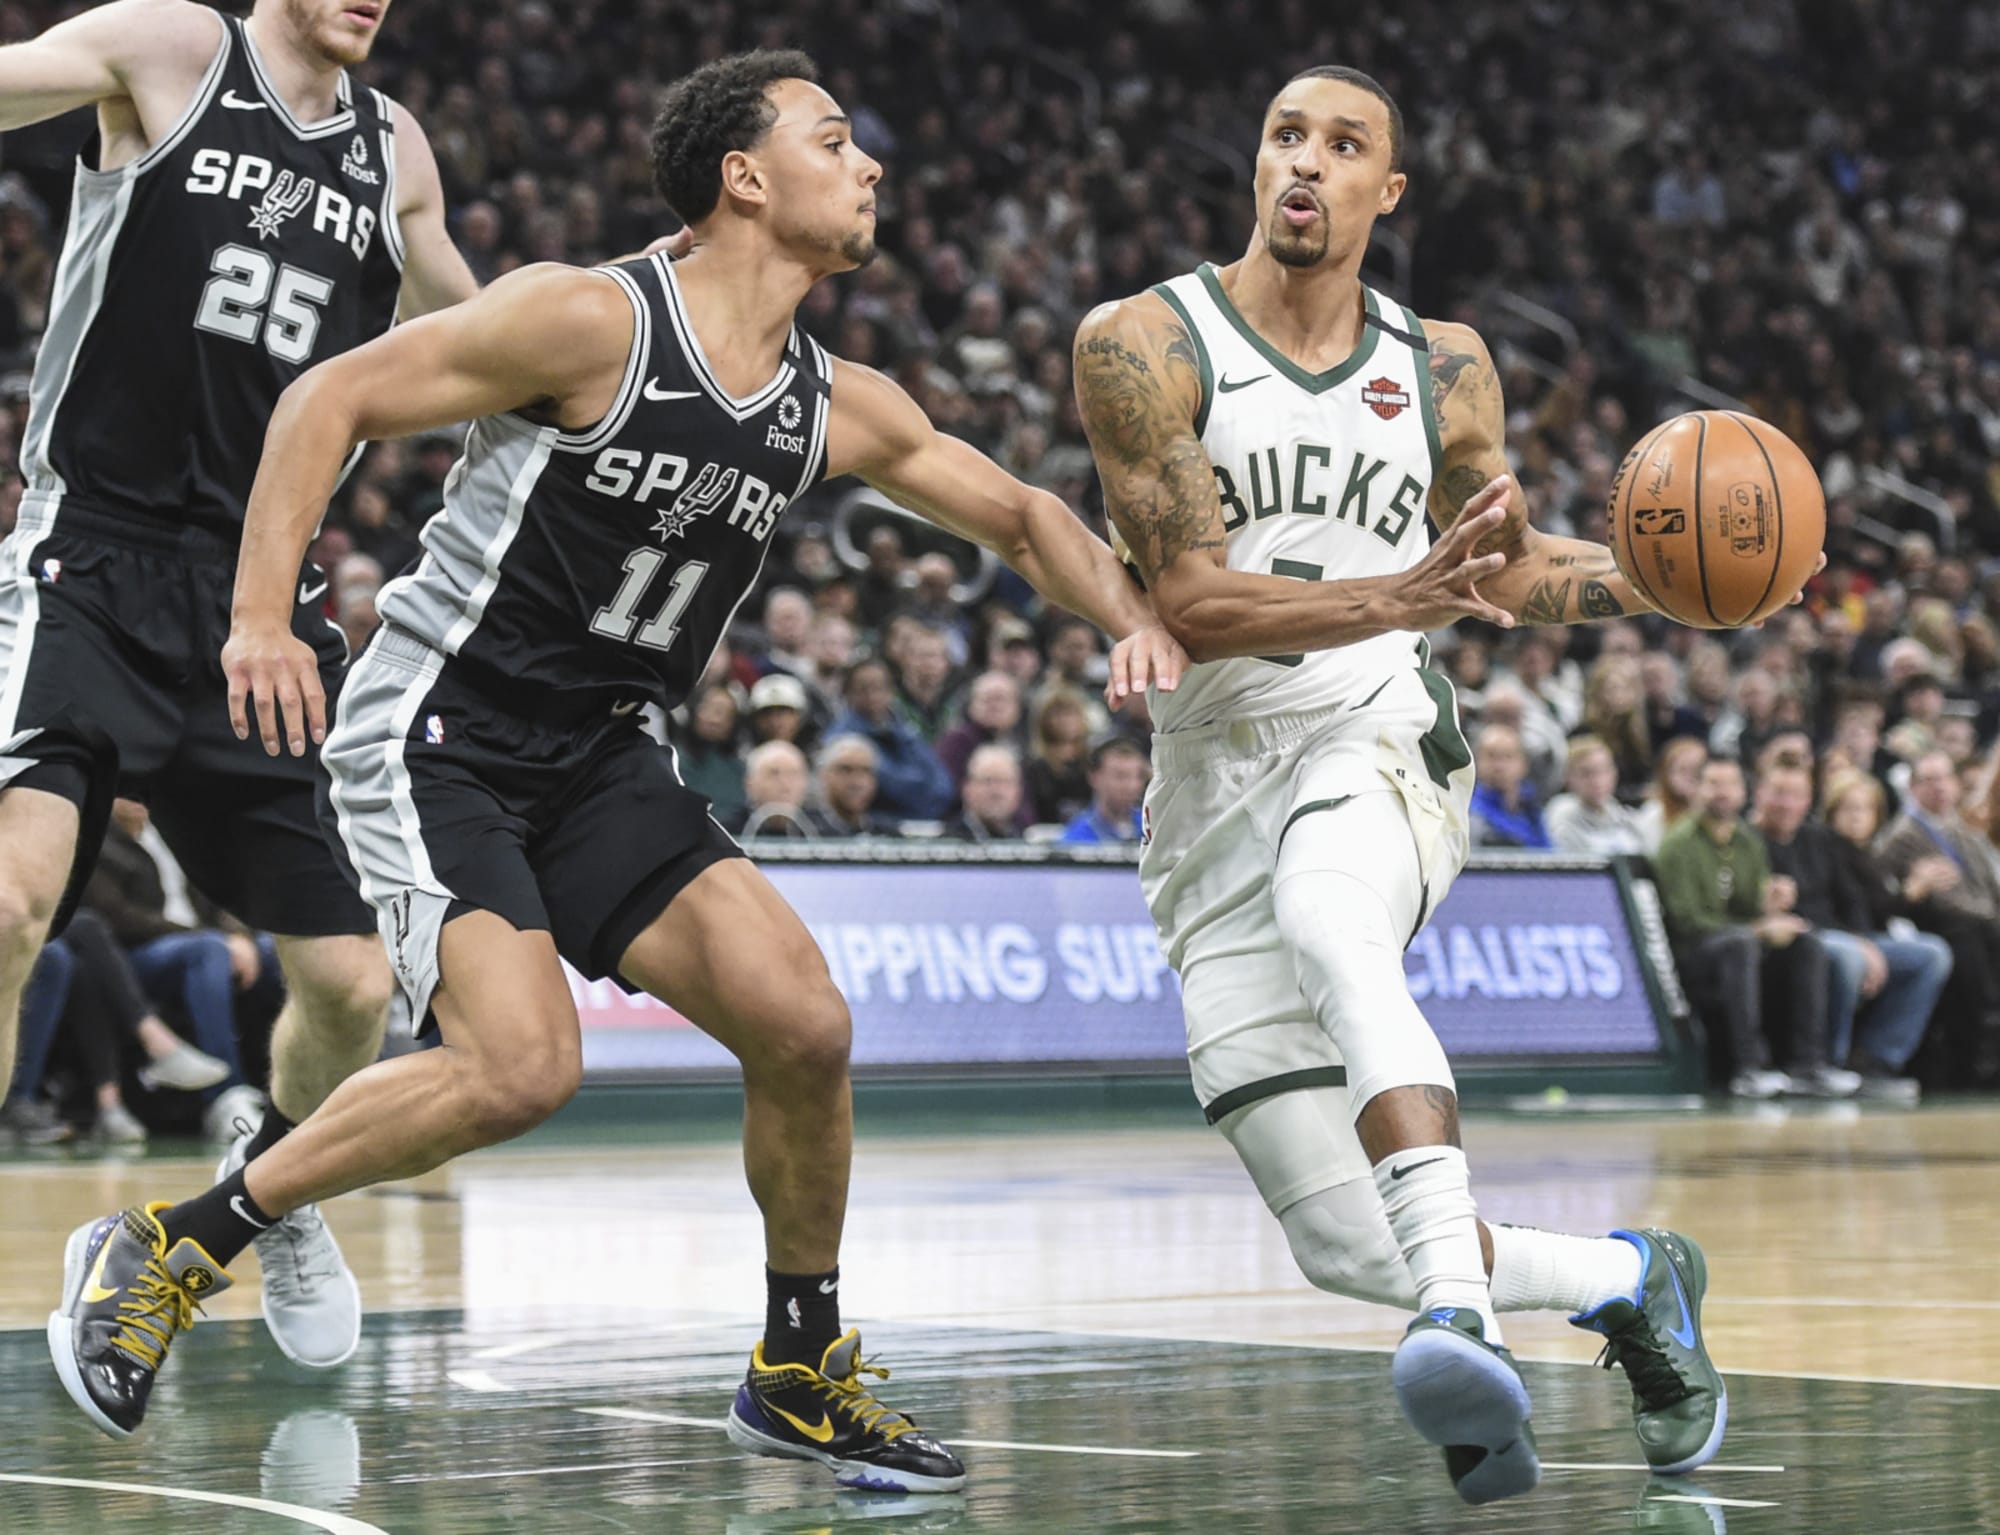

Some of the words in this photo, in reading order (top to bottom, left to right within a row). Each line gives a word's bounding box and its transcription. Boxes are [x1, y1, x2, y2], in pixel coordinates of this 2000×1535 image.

[185, 148, 376, 262] SPURS
[193, 242, 335, 365] 25
[765, 425, 807, 455] Frost
[585, 447, 788, 543] SPURS
[1212, 443, 1425, 548] BUCKS
[588, 546, 710, 652] 11
